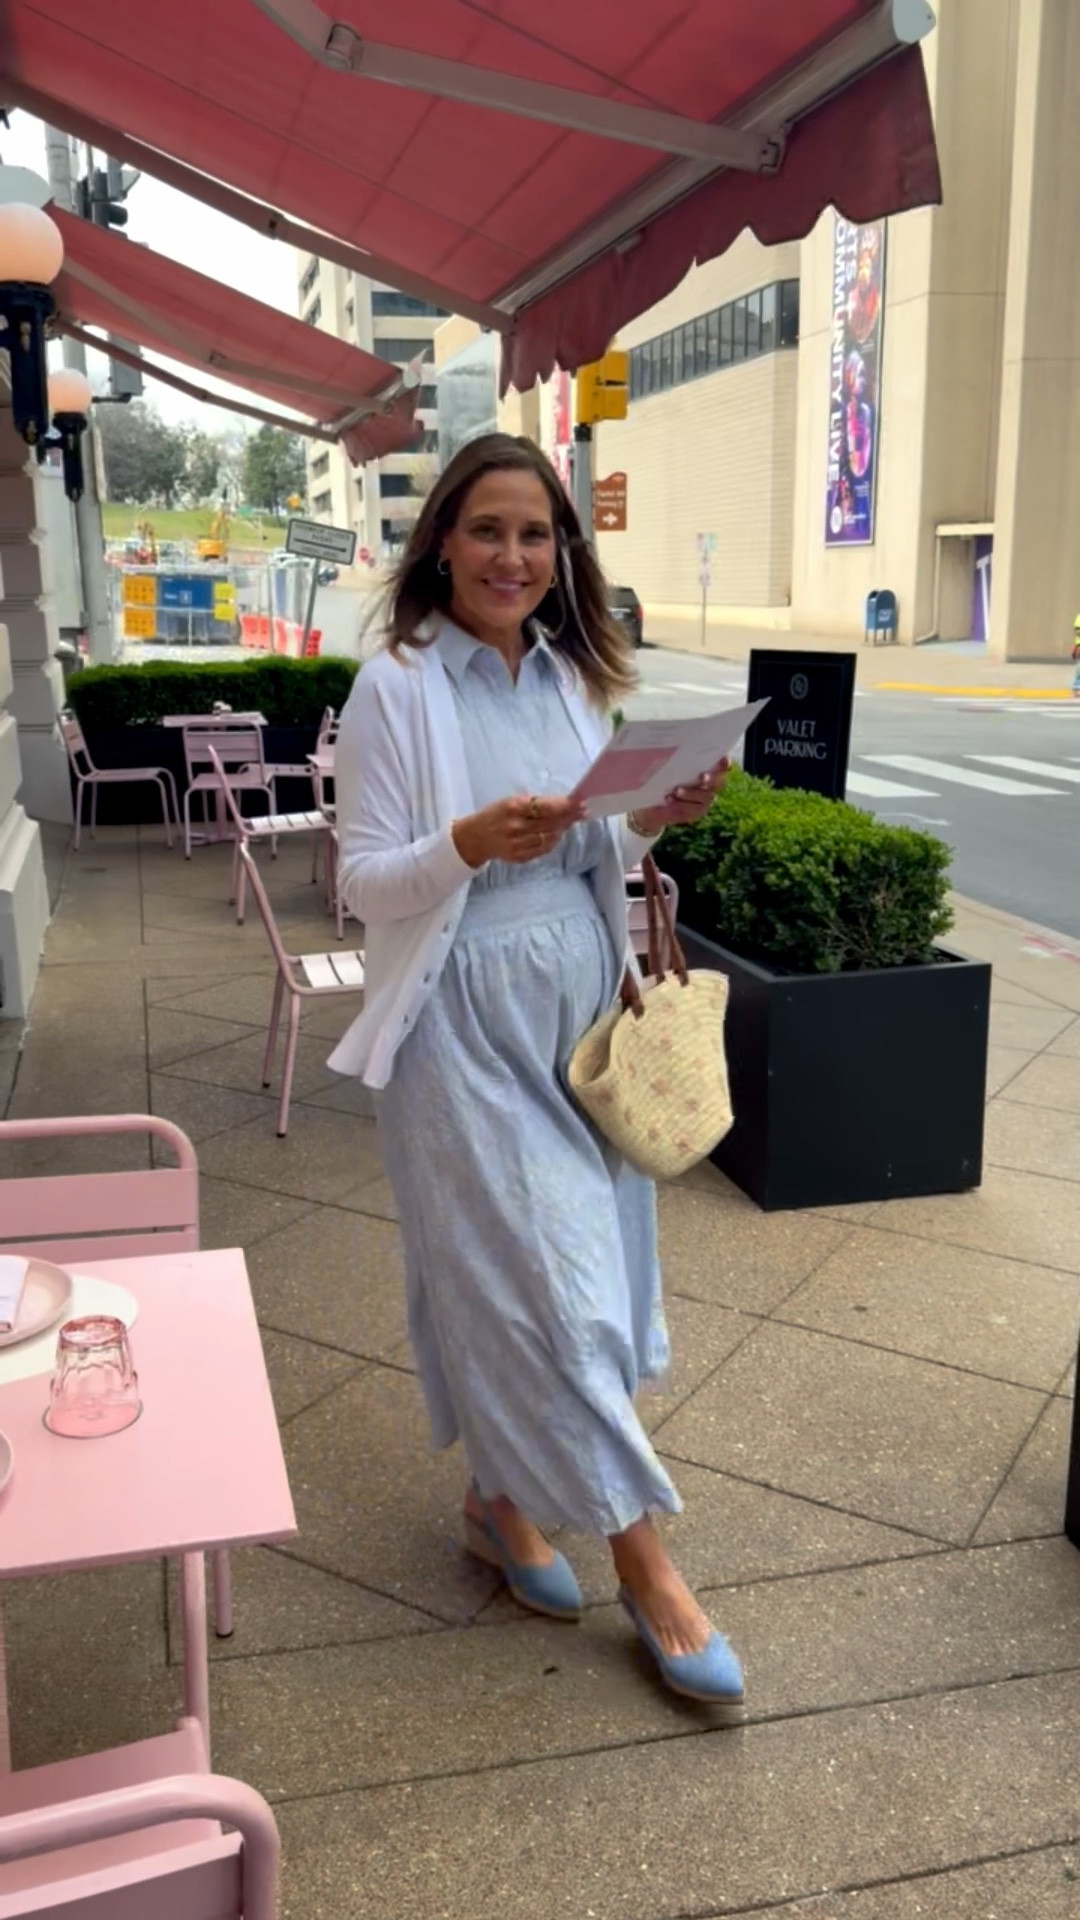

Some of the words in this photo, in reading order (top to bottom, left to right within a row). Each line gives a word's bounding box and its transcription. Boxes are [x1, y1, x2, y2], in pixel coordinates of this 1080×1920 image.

[846, 223, 858, 282] RTS
[832, 217, 846, 402] OMMUNITY
[828, 411, 843, 488] LIVE
[764, 738, 827, 760] PARKING
[777, 718, 816, 738] VALET
